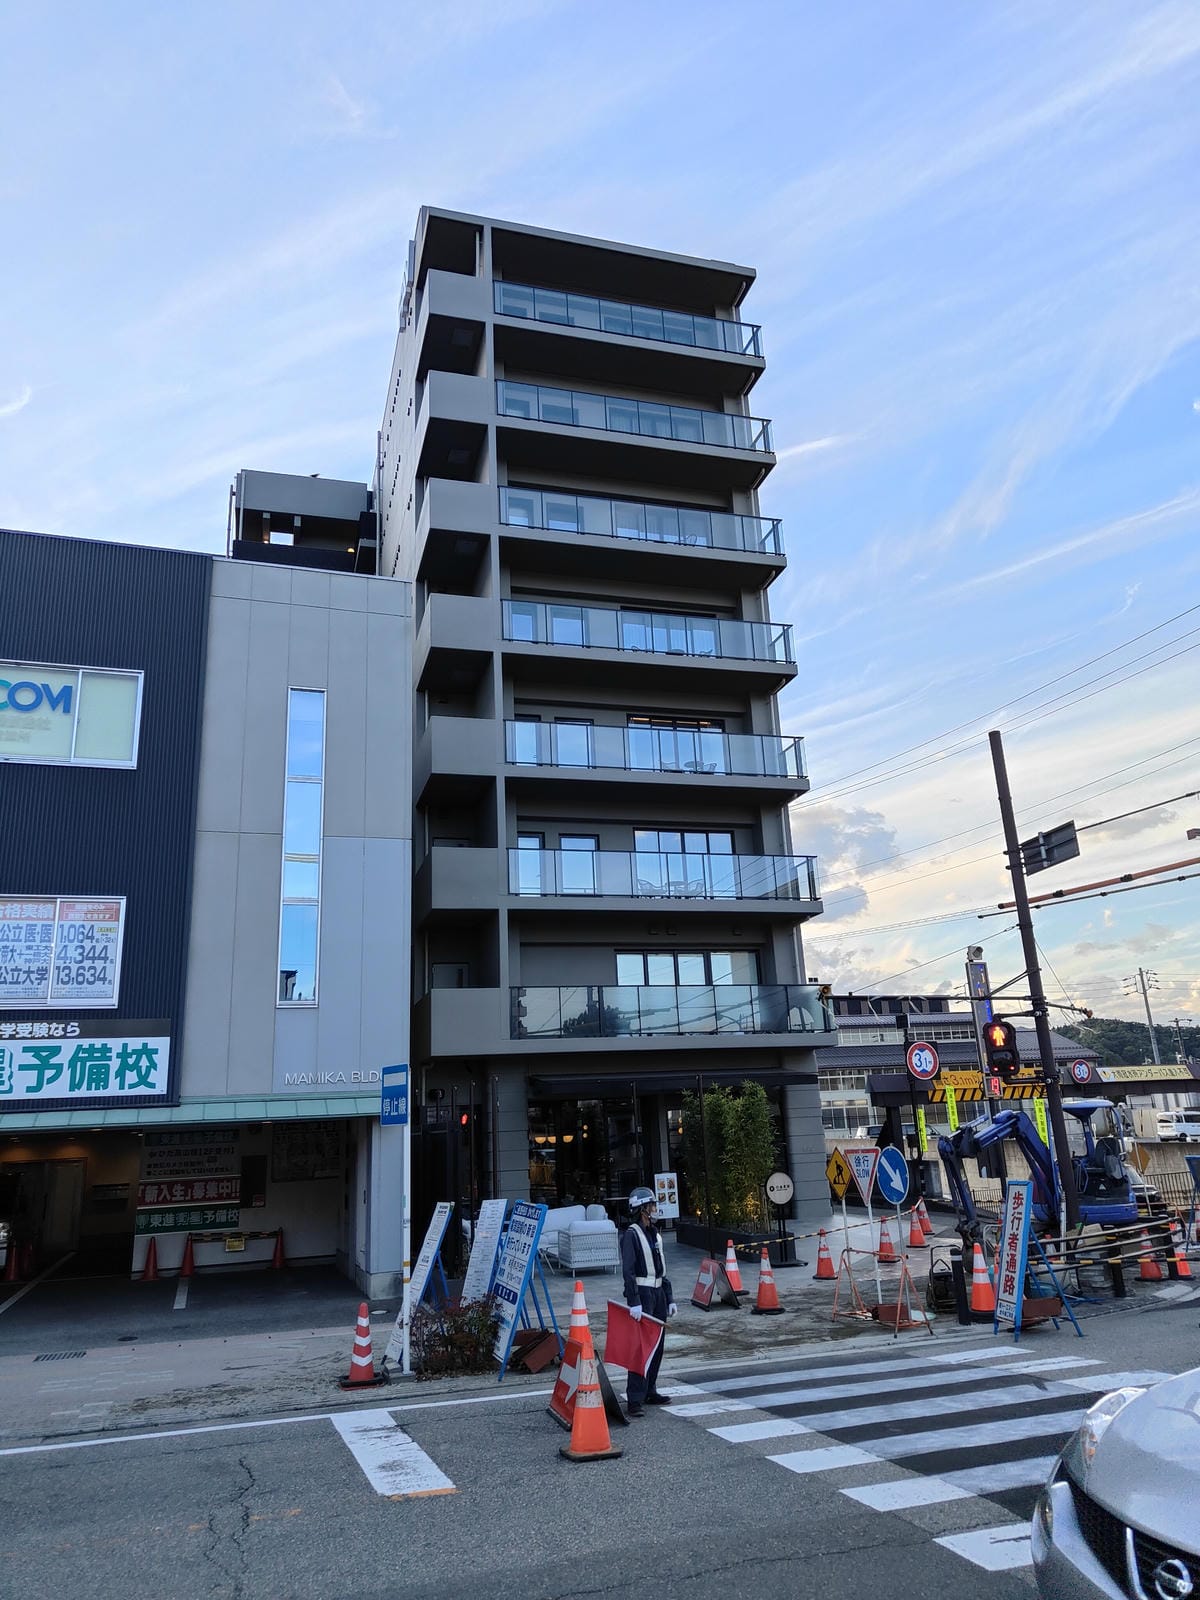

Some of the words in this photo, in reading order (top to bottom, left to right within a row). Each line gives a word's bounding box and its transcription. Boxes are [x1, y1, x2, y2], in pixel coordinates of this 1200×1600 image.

[0, 903, 54, 919] 格実績
[0, 1022, 81, 1038] 学受験なら
[351, 1070, 382, 1084] BLD
[856, 1168, 870, 1178] SLOW
[1002, 1190, 1024, 1297] 歩行者通路
